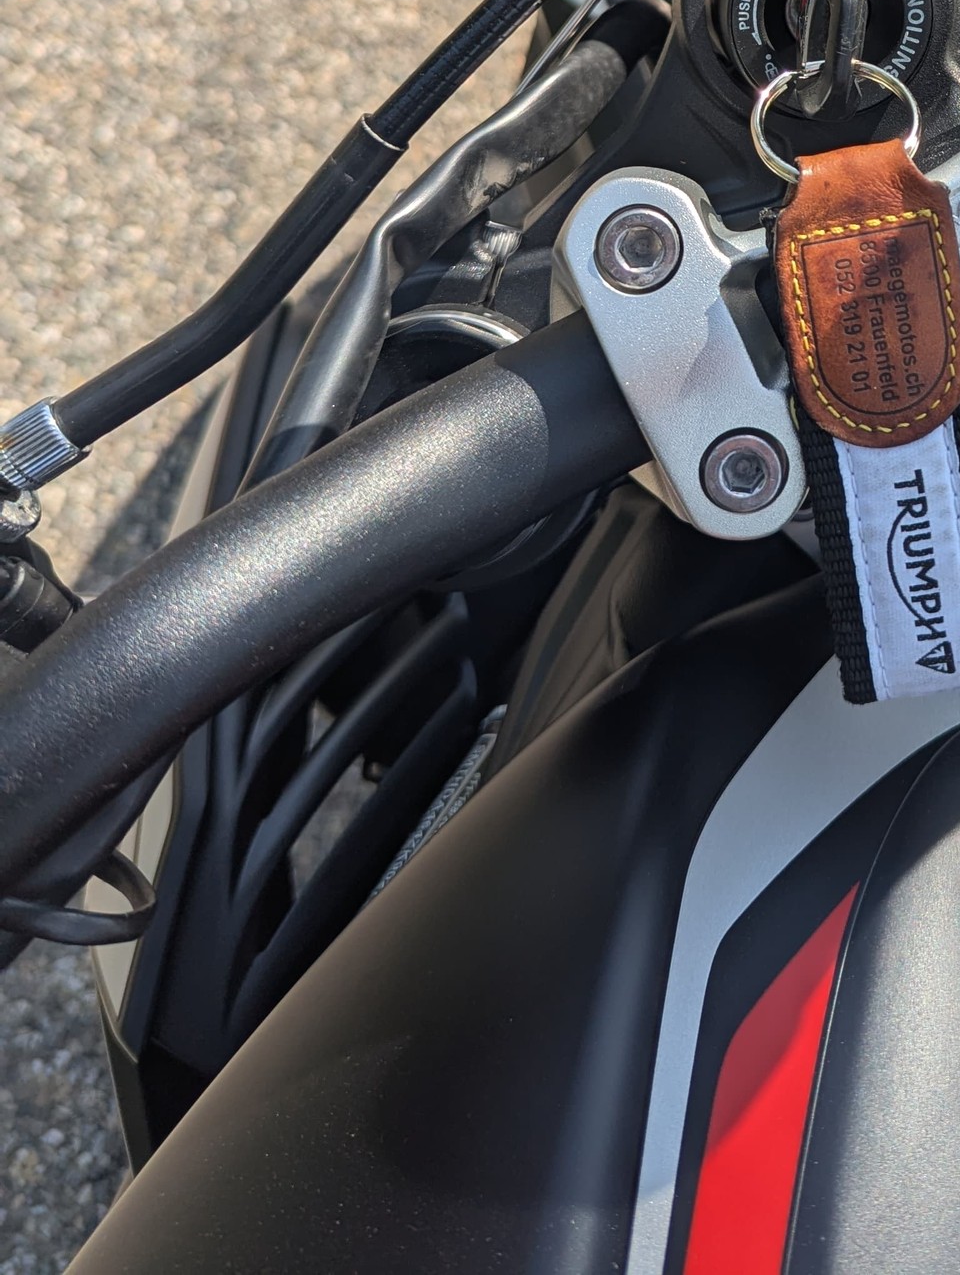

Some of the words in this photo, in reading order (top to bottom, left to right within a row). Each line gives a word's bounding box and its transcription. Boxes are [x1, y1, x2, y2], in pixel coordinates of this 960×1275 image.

[835, 258, 857, 295] 052
[859, 240, 882, 288] 8500
[841, 300, 863, 337] 319
[847, 342, 868, 364] 21
[867, 293, 900, 403] Frauenfeld
[852, 371, 872, 393] 01
[889, 469, 947, 642] TRIUMPH
